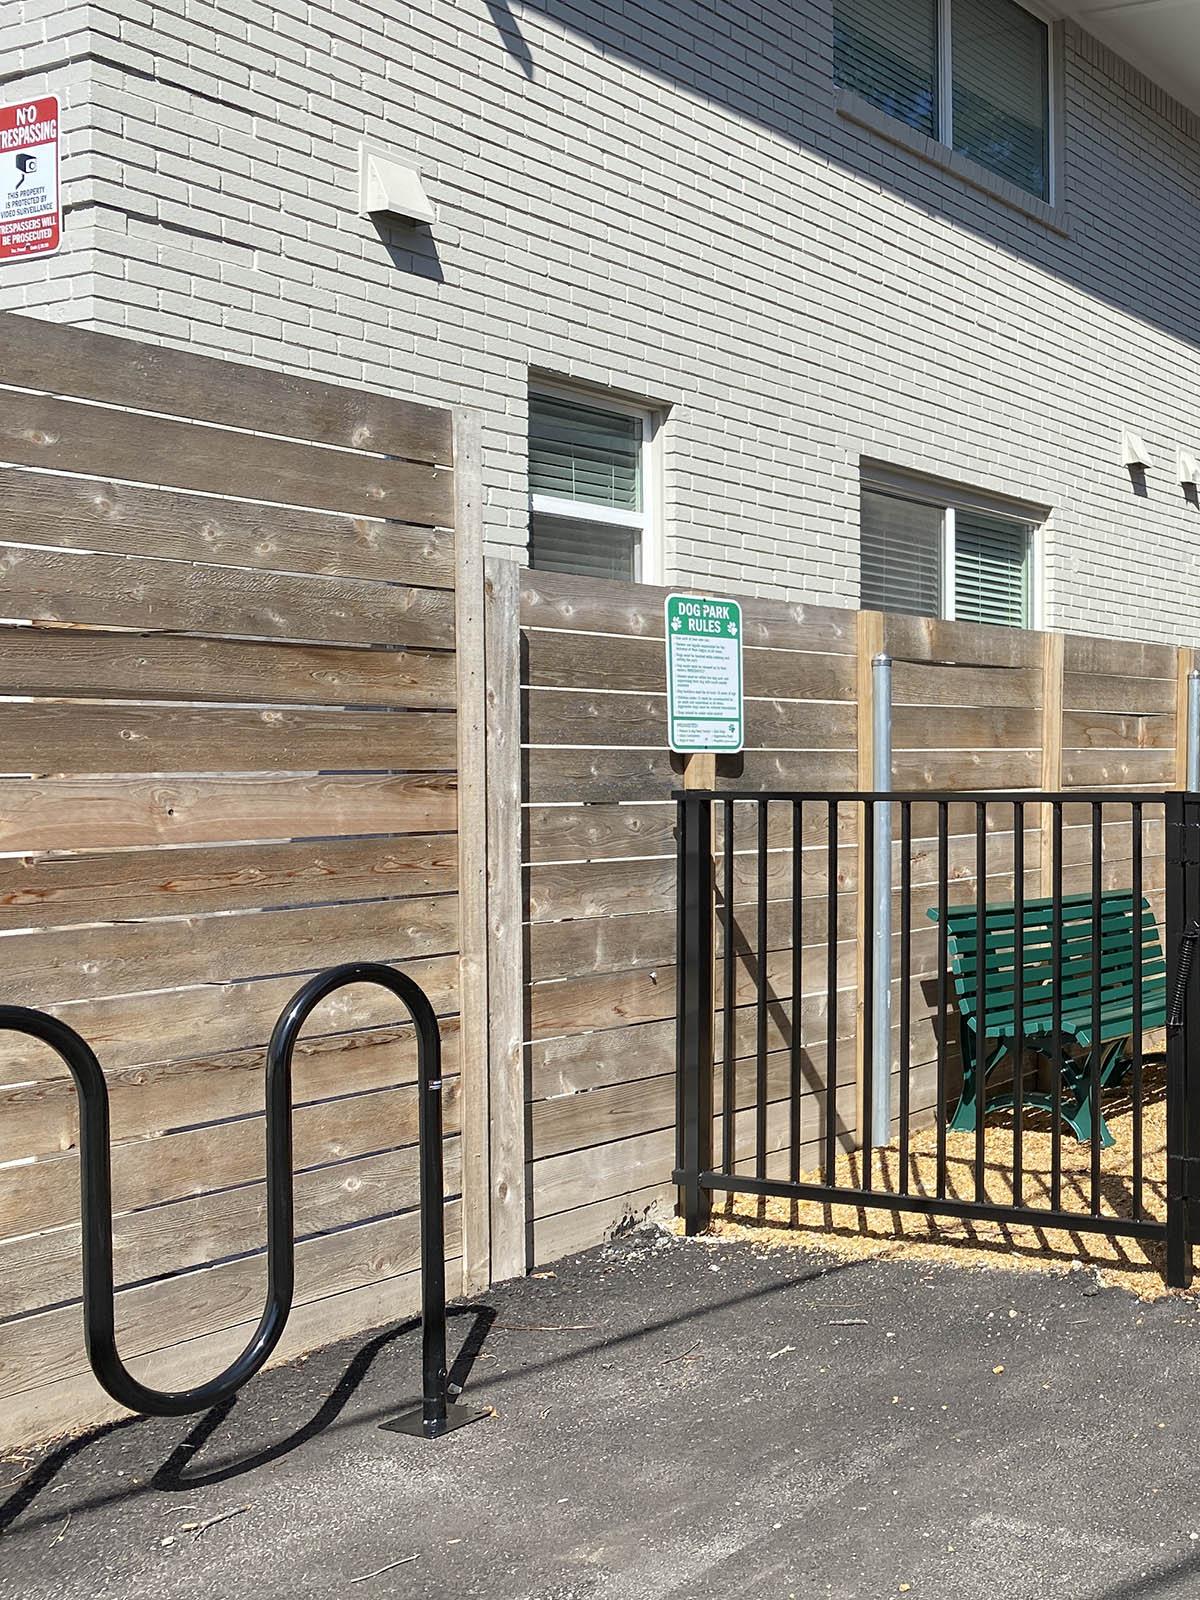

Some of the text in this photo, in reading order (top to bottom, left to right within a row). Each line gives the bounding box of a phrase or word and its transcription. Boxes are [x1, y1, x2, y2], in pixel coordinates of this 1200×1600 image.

[16, 104, 37, 126] NO
[20, 186, 45, 197] PROPERTY
[5, 194, 47, 209] IS PROTECTED BY
[0, 202, 53, 220] VIDEO SURVEILLANCE
[41, 215, 57, 227] WILL
[2, 228, 52, 246] BE PROSECUTED
[678, 602, 730, 620] DOG PARK
[688, 617, 721, 634] RULES
